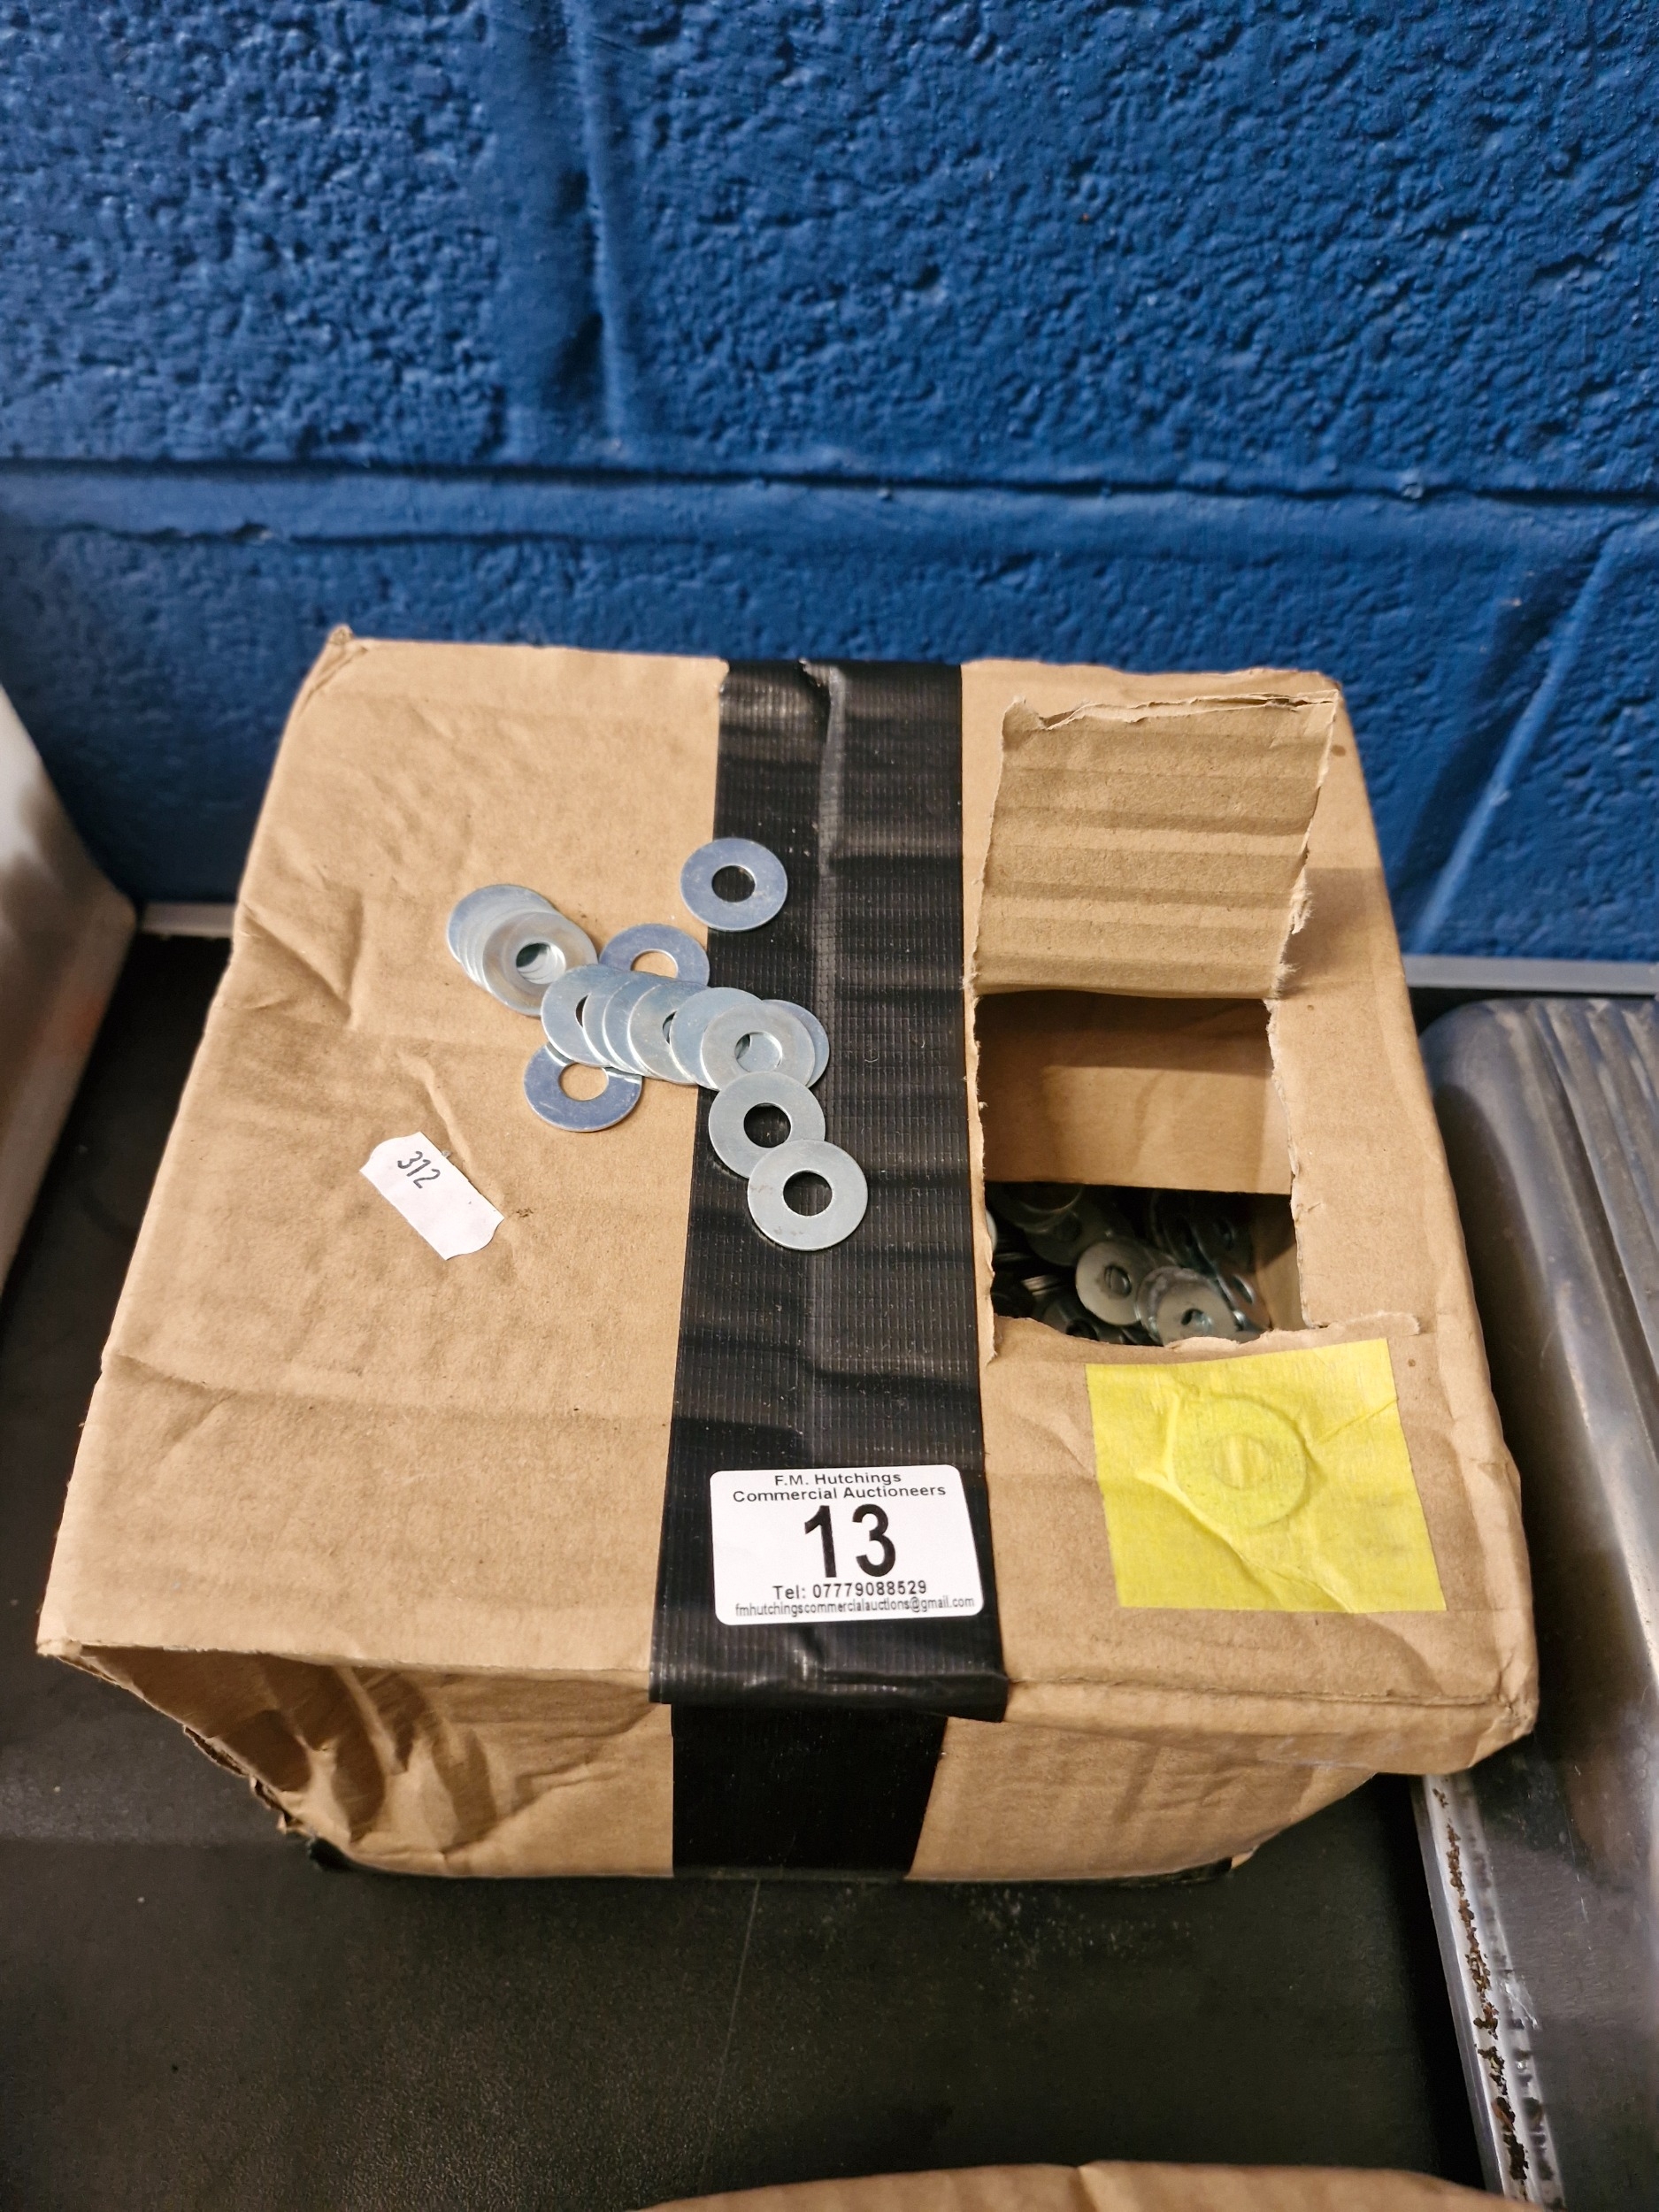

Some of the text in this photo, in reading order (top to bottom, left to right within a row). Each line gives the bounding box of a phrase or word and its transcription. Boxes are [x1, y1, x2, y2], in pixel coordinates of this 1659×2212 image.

[397, 1150, 441, 1188] 312
[774, 1472, 902, 1486] F.M. Hutchings
[733, 1485, 947, 1502] Commercial Auctioneers
[804, 1503, 896, 1578] 13
[772, 1579, 927, 1600] Tel: 07779088529
[734, 1595, 975, 1617] fmhutchingscommercialauctions@gmail.com
